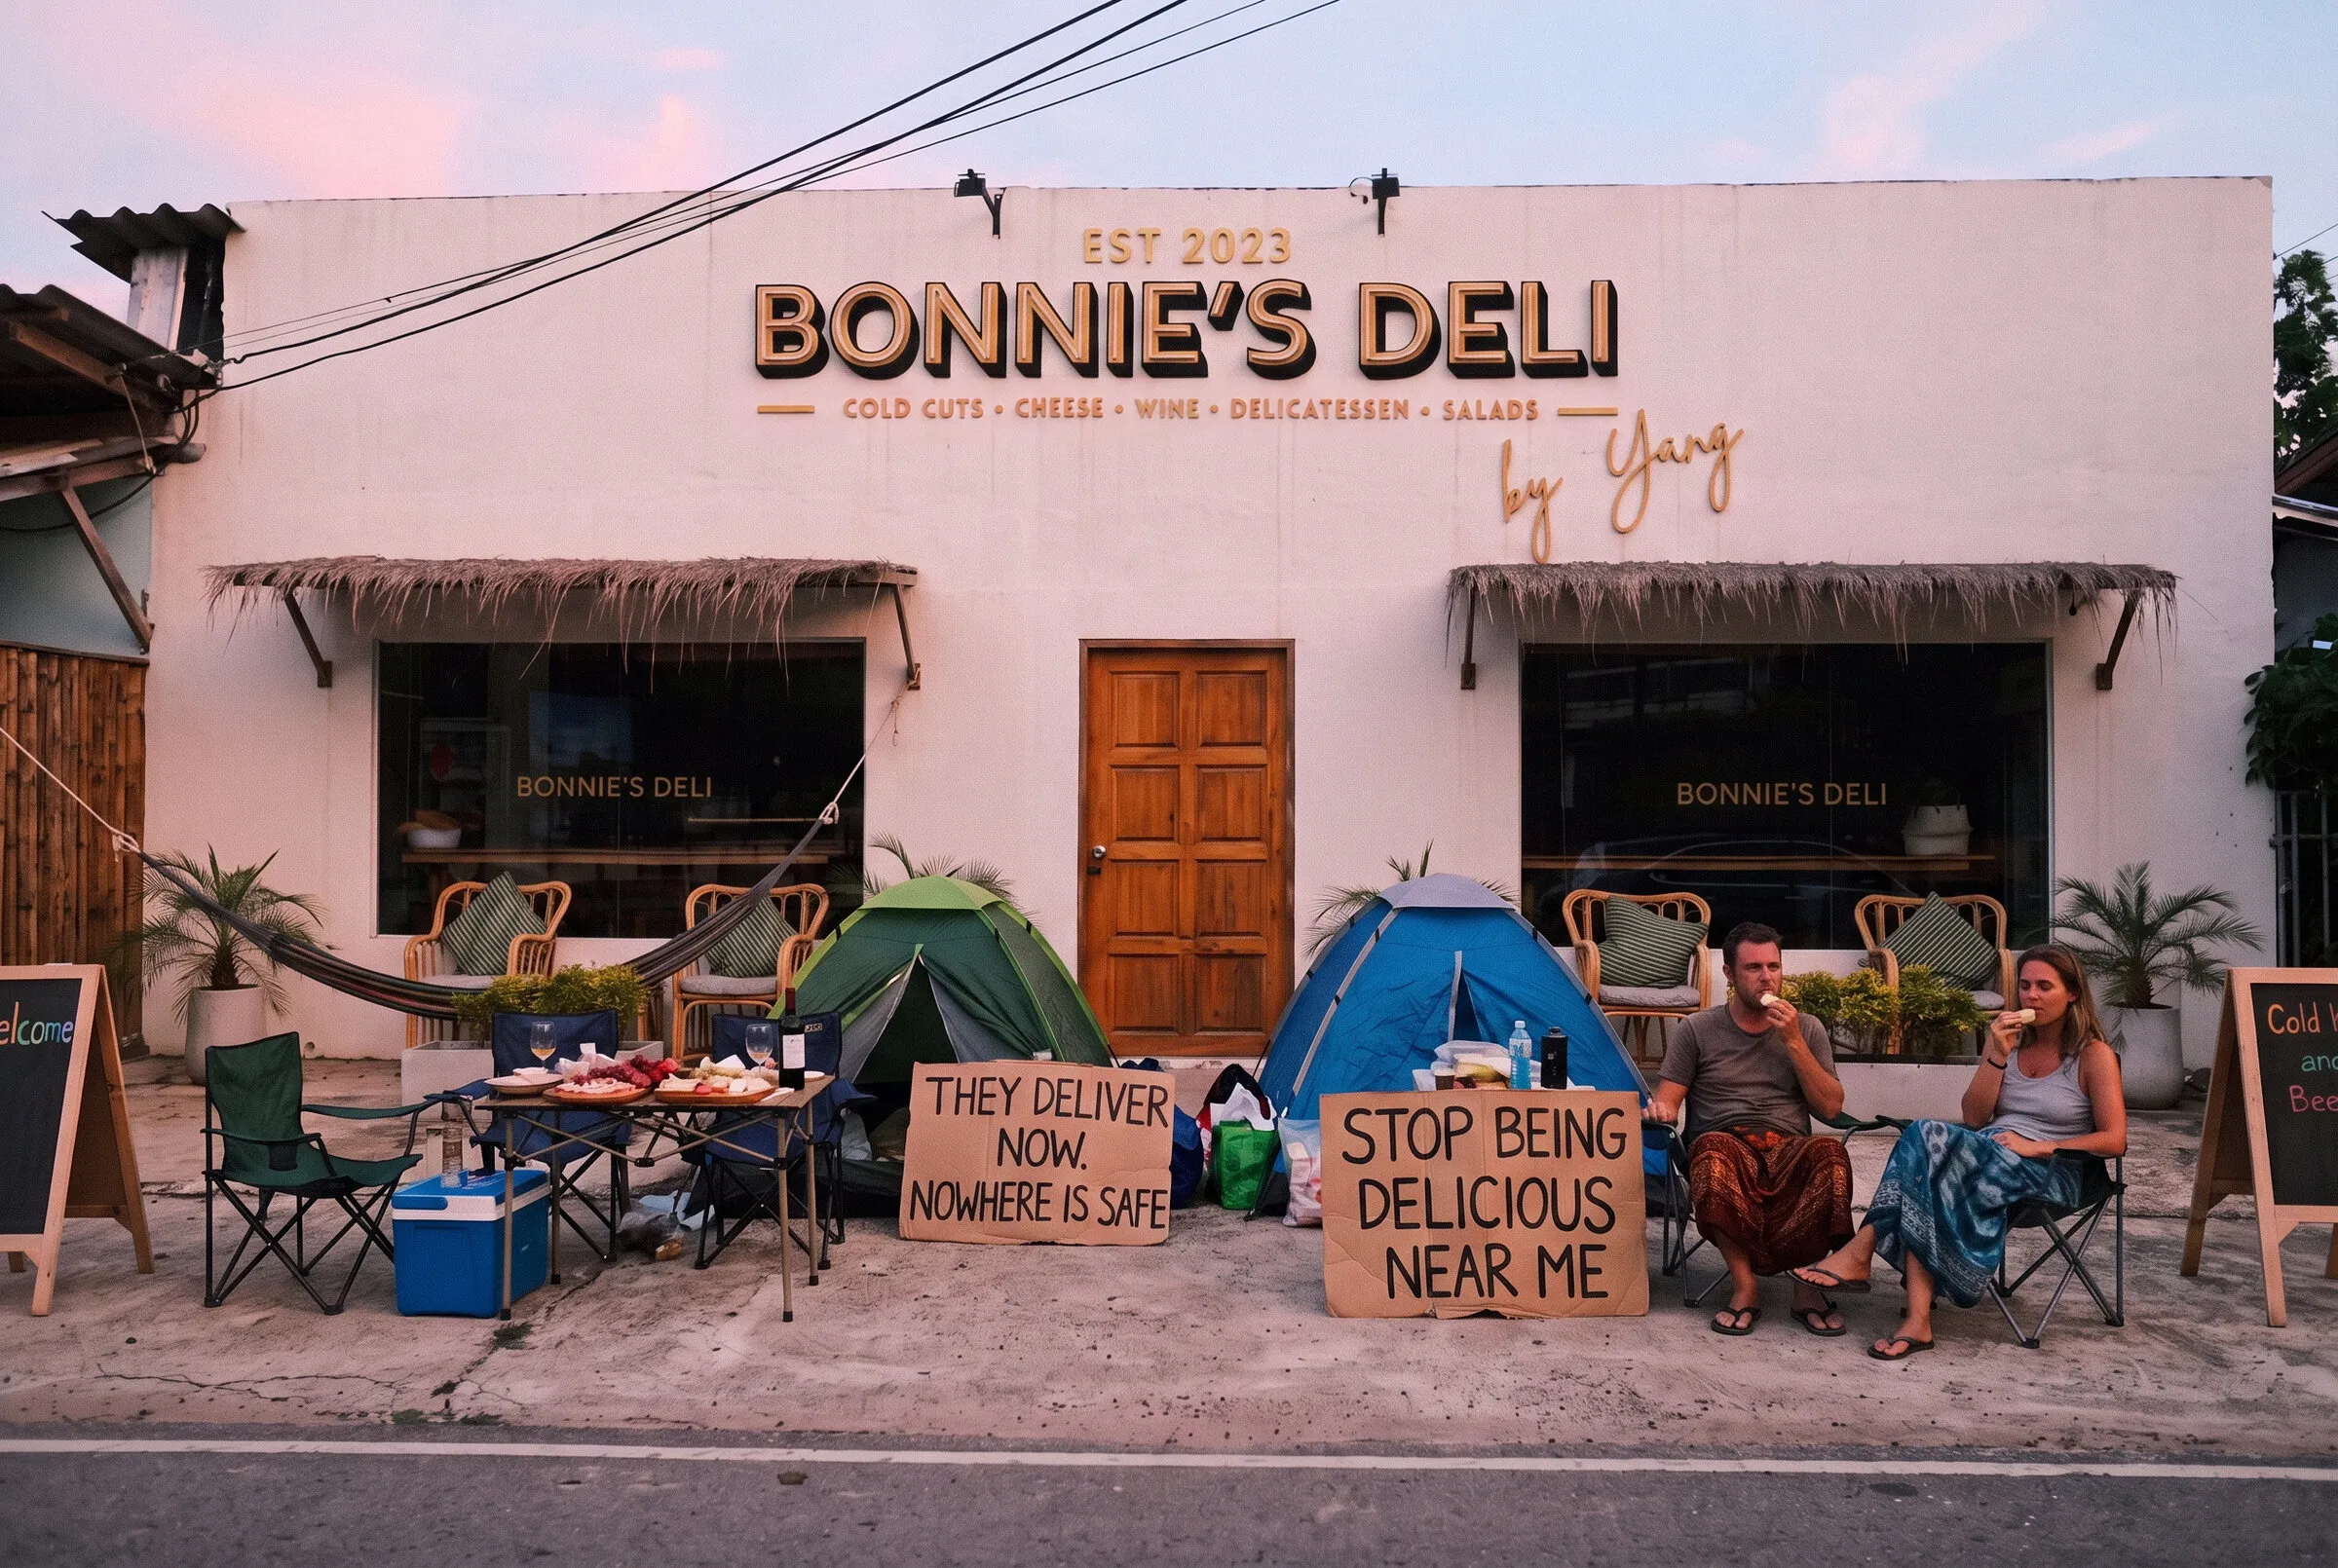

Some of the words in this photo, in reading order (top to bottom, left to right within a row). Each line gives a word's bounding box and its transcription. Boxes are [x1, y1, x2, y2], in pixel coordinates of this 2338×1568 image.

[1083, 227, 1161, 265] EST
[1183, 227, 1293, 266] 2023
[755, 279, 1317, 381] BONNIE'S
[1358, 280, 1618, 380] DELI
[844, 397, 912, 420] COLD
[922, 397, 985, 420] CUTS
[1014, 396, 1104, 419] CHEESE
[1135, 398, 1199, 420] WINE
[1230, 397, 1410, 420] DELICATESSEN
[1443, 398, 1539, 421] SALADS
[1502, 438, 1563, 564] by
[1606, 409, 1744, 535] Yang
[516, 775, 645, 799] BONNIE'S
[654, 776, 712, 798] DELI
[1677, 782, 1815, 805] BONNIE'S
[1825, 782, 1887, 805] DELI
[2267, 1001, 2320, 1034] Cold
[925, 1076, 1022, 1116] THEY
[1034, 1077, 1169, 1129] DELIVER
[997, 1127, 1087, 1171] NOW.
[1341, 1105, 1474, 1165] STOP
[1494, 1107, 1628, 1160] BEING
[909, 1179, 1053, 1222] NOWHERE
[1063, 1184, 1089, 1223] IS
[1097, 1186, 1169, 1229] SAFE
[1358, 1176, 1616, 1235] DELICIOUS
[1386, 1243, 1520, 1300] NEAR
[1537, 1243, 1609, 1300] ME
